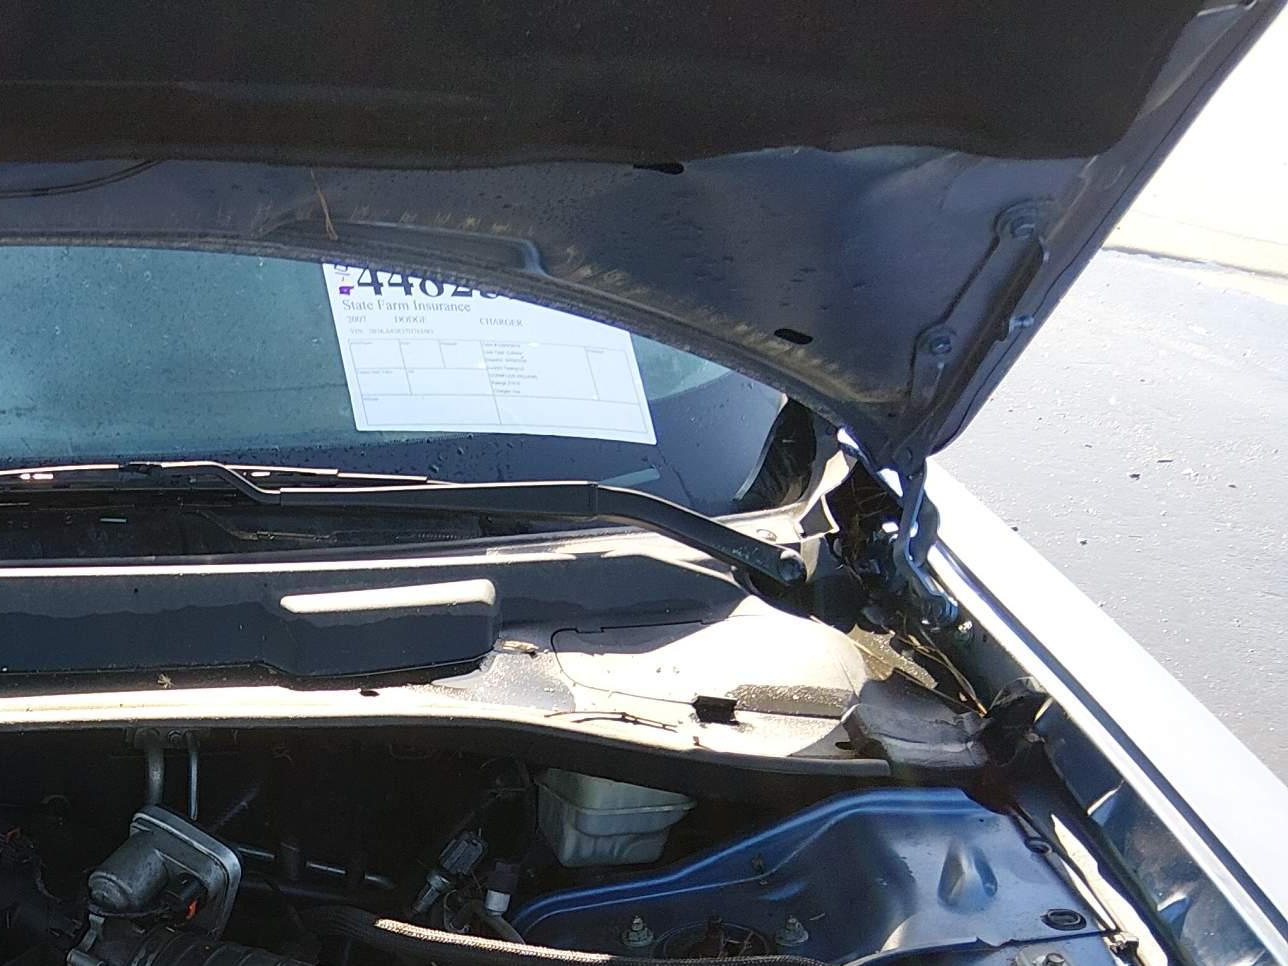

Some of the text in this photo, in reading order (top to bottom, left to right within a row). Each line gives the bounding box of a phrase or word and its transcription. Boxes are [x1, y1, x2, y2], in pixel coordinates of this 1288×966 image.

[343, 300, 471, 312] State Farm Insurance
[479, 318, 523, 327] CHARGER
